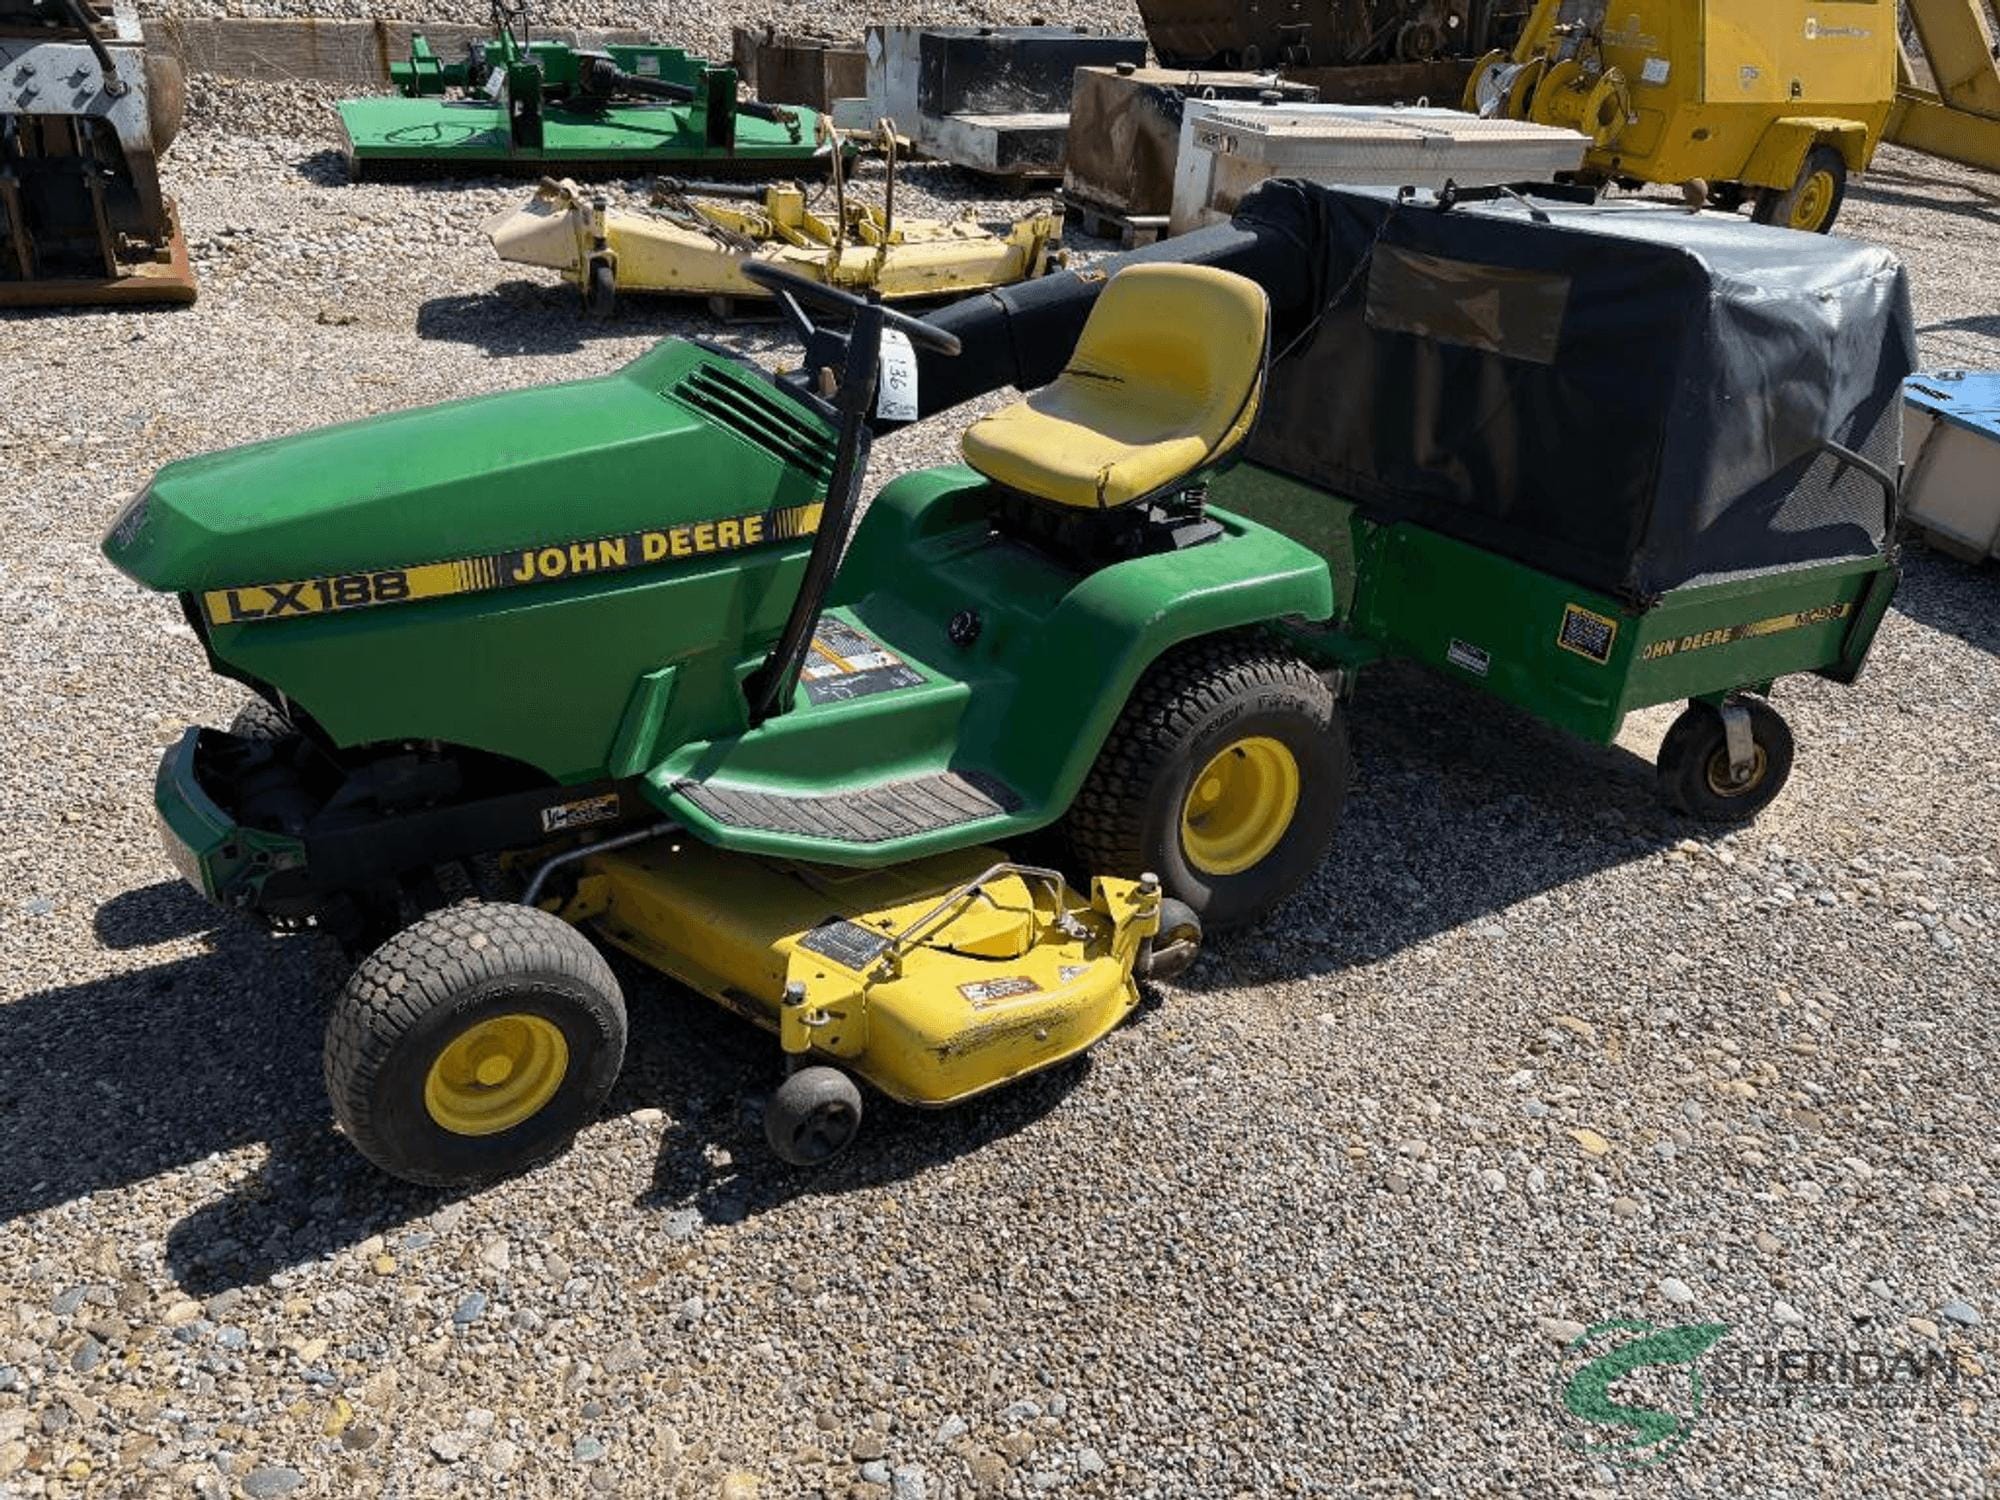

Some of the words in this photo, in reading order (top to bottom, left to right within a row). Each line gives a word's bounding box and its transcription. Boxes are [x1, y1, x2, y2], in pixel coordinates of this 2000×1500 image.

[226, 572, 410, 619] LX188
[513, 538, 627, 582] JOHN
[642, 515, 764, 562] DEERE
[1641, 638, 1677, 661] OHN
[1680, 627, 1733, 652] DEERE
